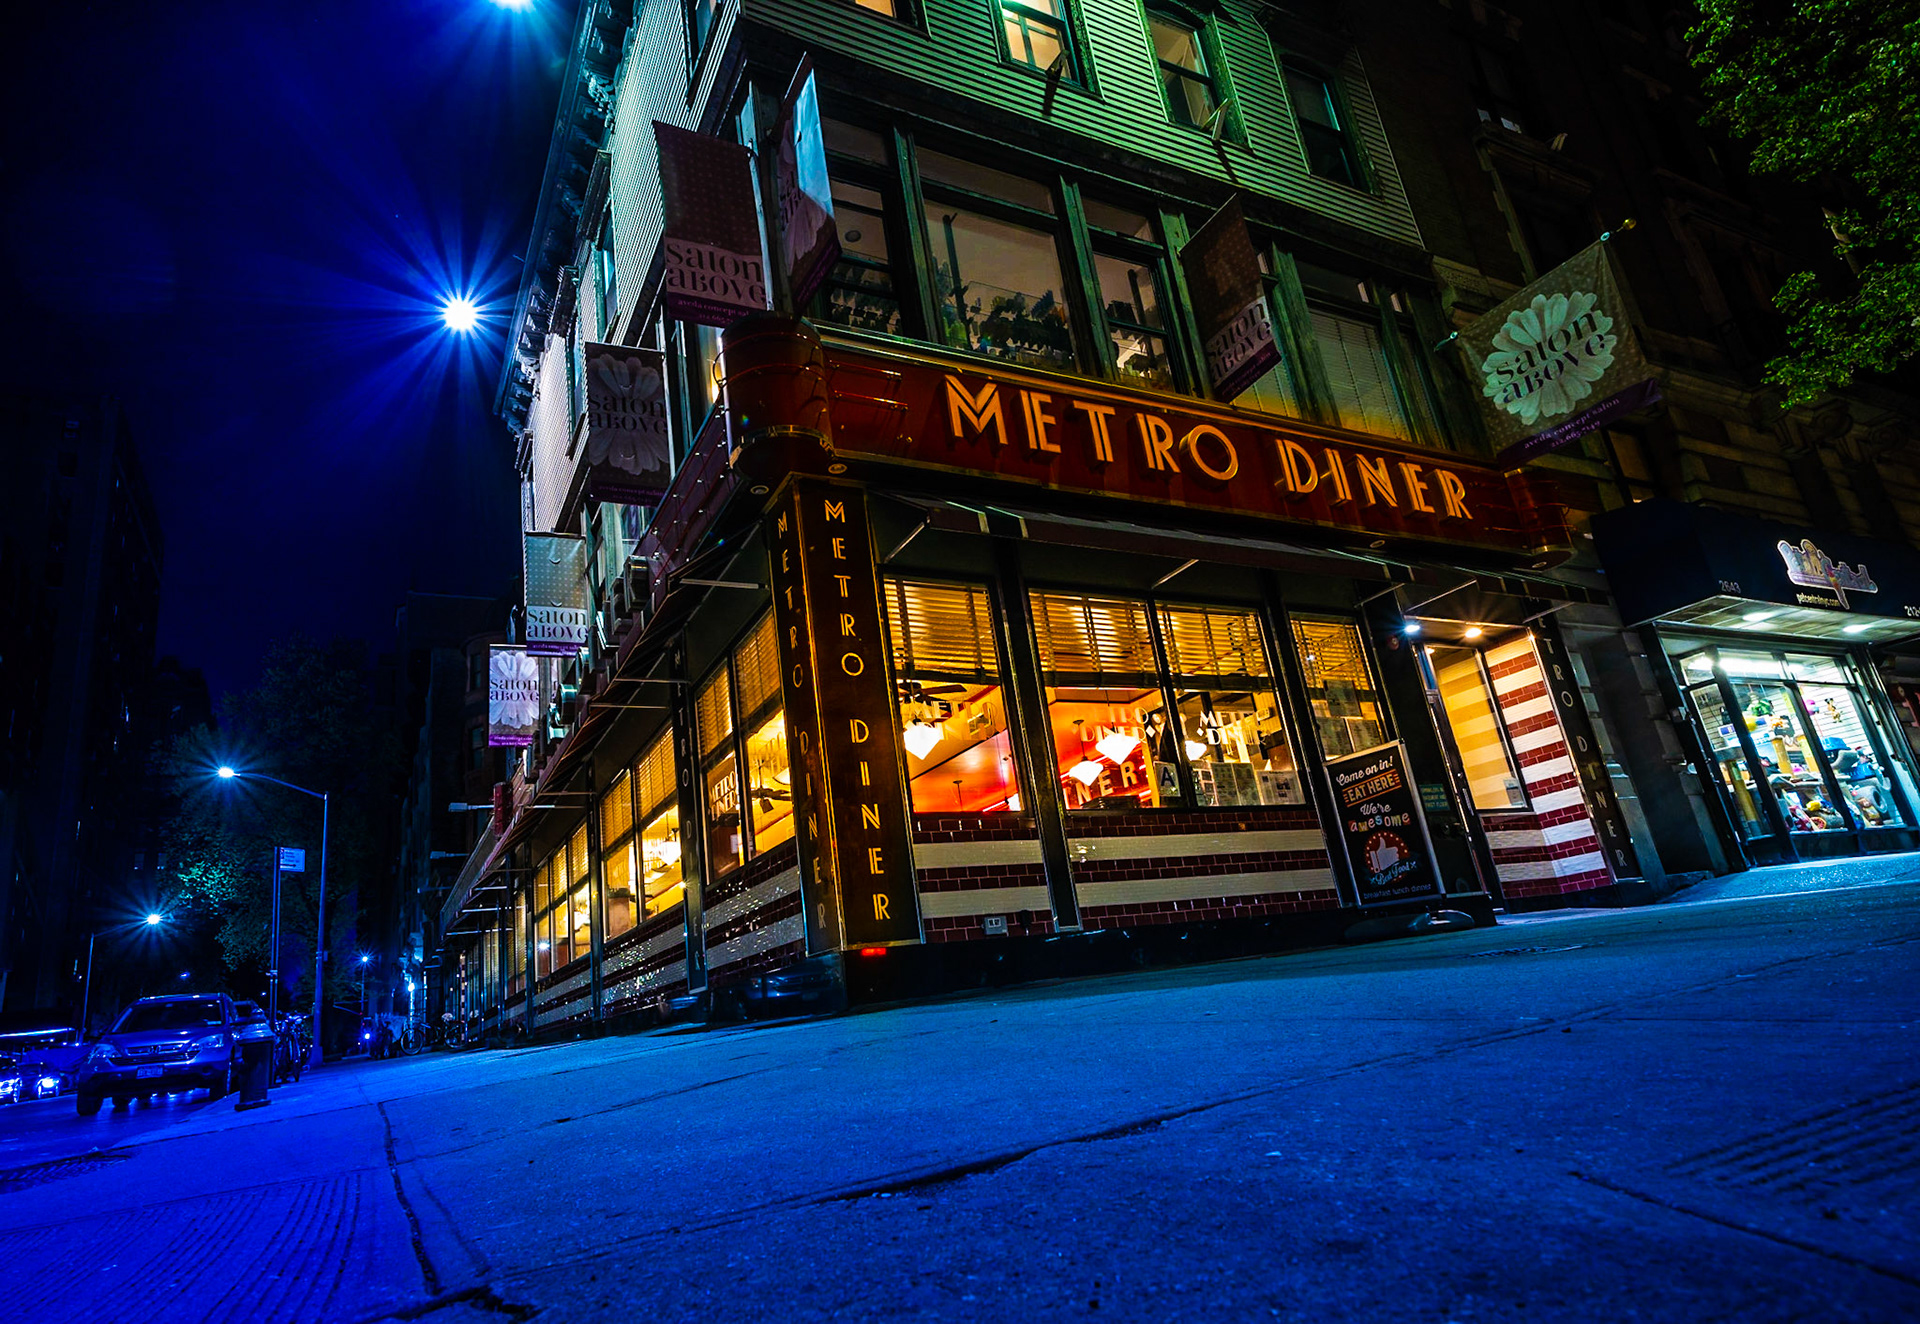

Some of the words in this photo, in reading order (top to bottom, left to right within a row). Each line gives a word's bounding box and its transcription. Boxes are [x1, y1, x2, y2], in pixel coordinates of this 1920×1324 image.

[944, 374, 1239, 484] METRO
[1275, 438, 1474, 522] DINER
[777, 509, 804, 689] METRO
[824, 499, 865, 677] METRO
[800, 730, 827, 930] DINER
[850, 718, 891, 921] DINER
[1161, 766, 1176, 787] A
[1336, 769, 1365, 786] Come
[1365, 764, 1378, 776] on
[1347, 784, 1367, 802] EAT
[1367, 773, 1396, 795] HERE
[1360, 802, 1392, 816] We're
